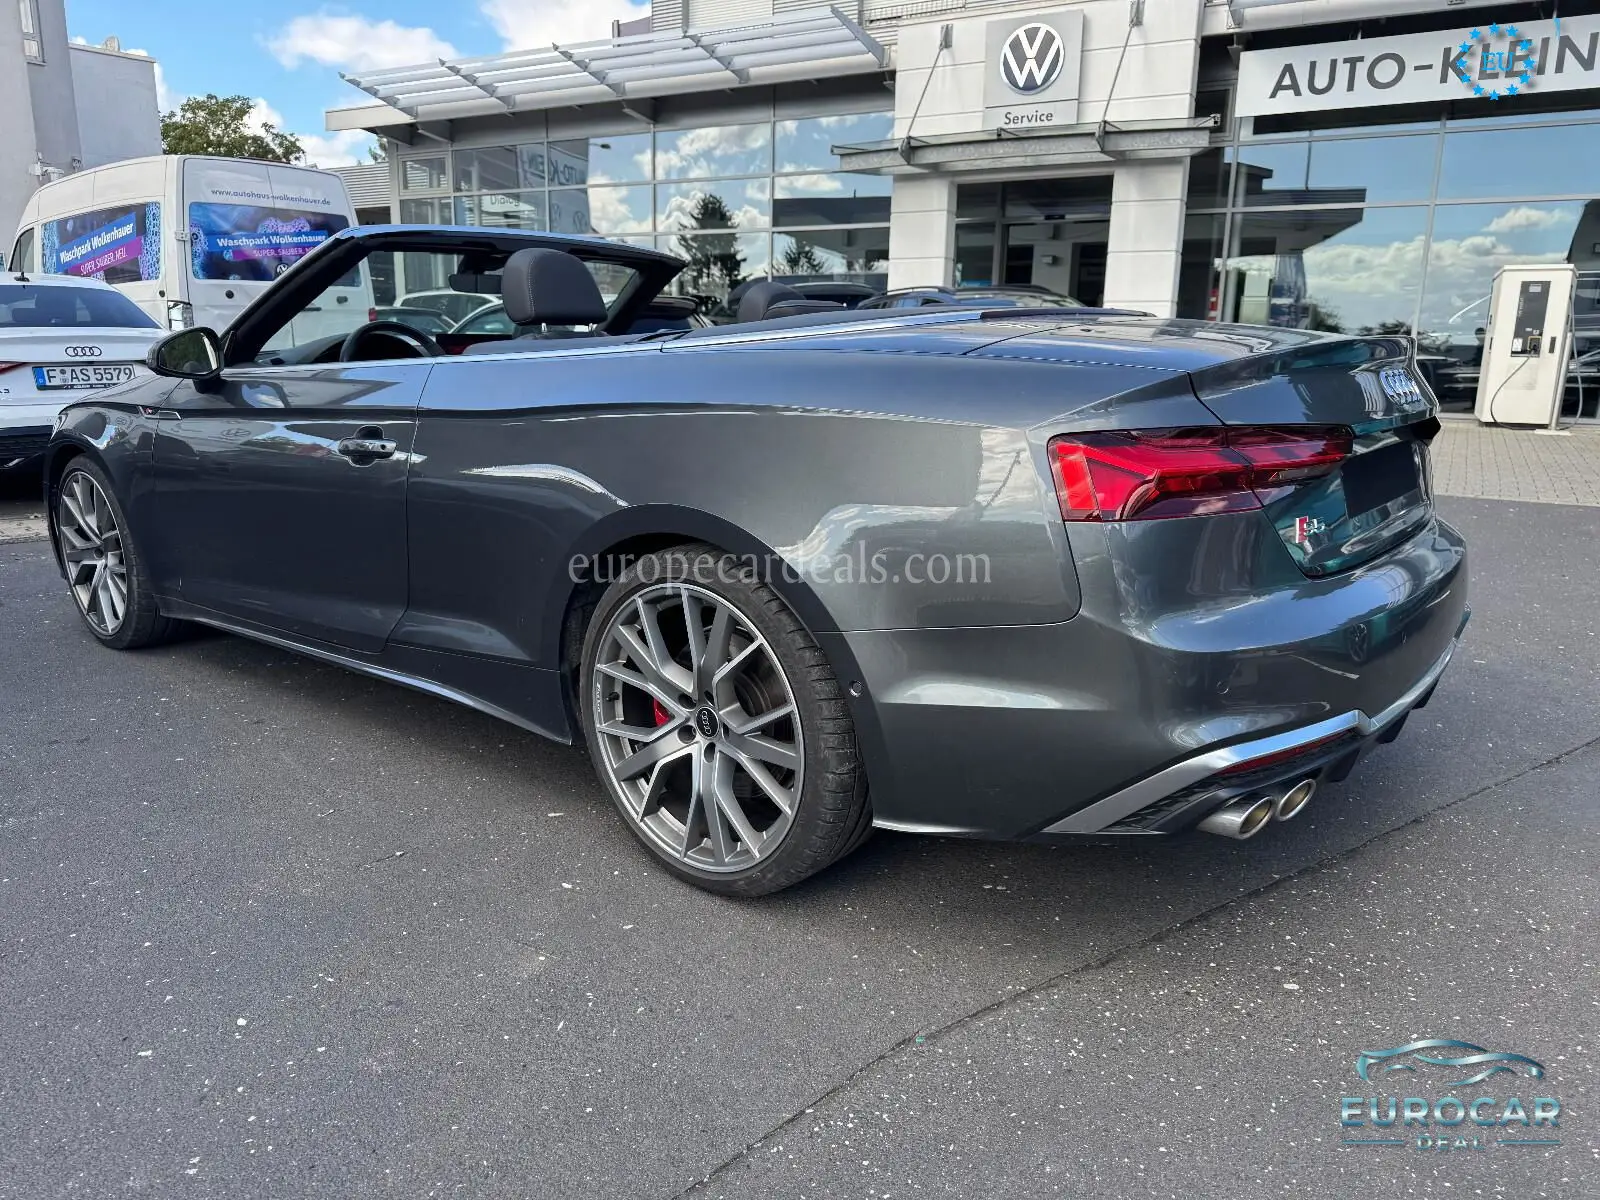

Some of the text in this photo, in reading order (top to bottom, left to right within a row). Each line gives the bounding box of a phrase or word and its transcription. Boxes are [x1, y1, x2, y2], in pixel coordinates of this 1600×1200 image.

[1269, 31, 1600, 99] AUTO-KLEIN
[1004, 110, 1054, 126] Service
[211, 188, 331, 206] www.autohaus-wolkenhauer.de
[60, 222, 134, 265] Waschpark Wolkenhauer
[217, 234, 327, 247] Waschpark Wolkenhauer
[46, 366, 133, 383] F AS 5579
